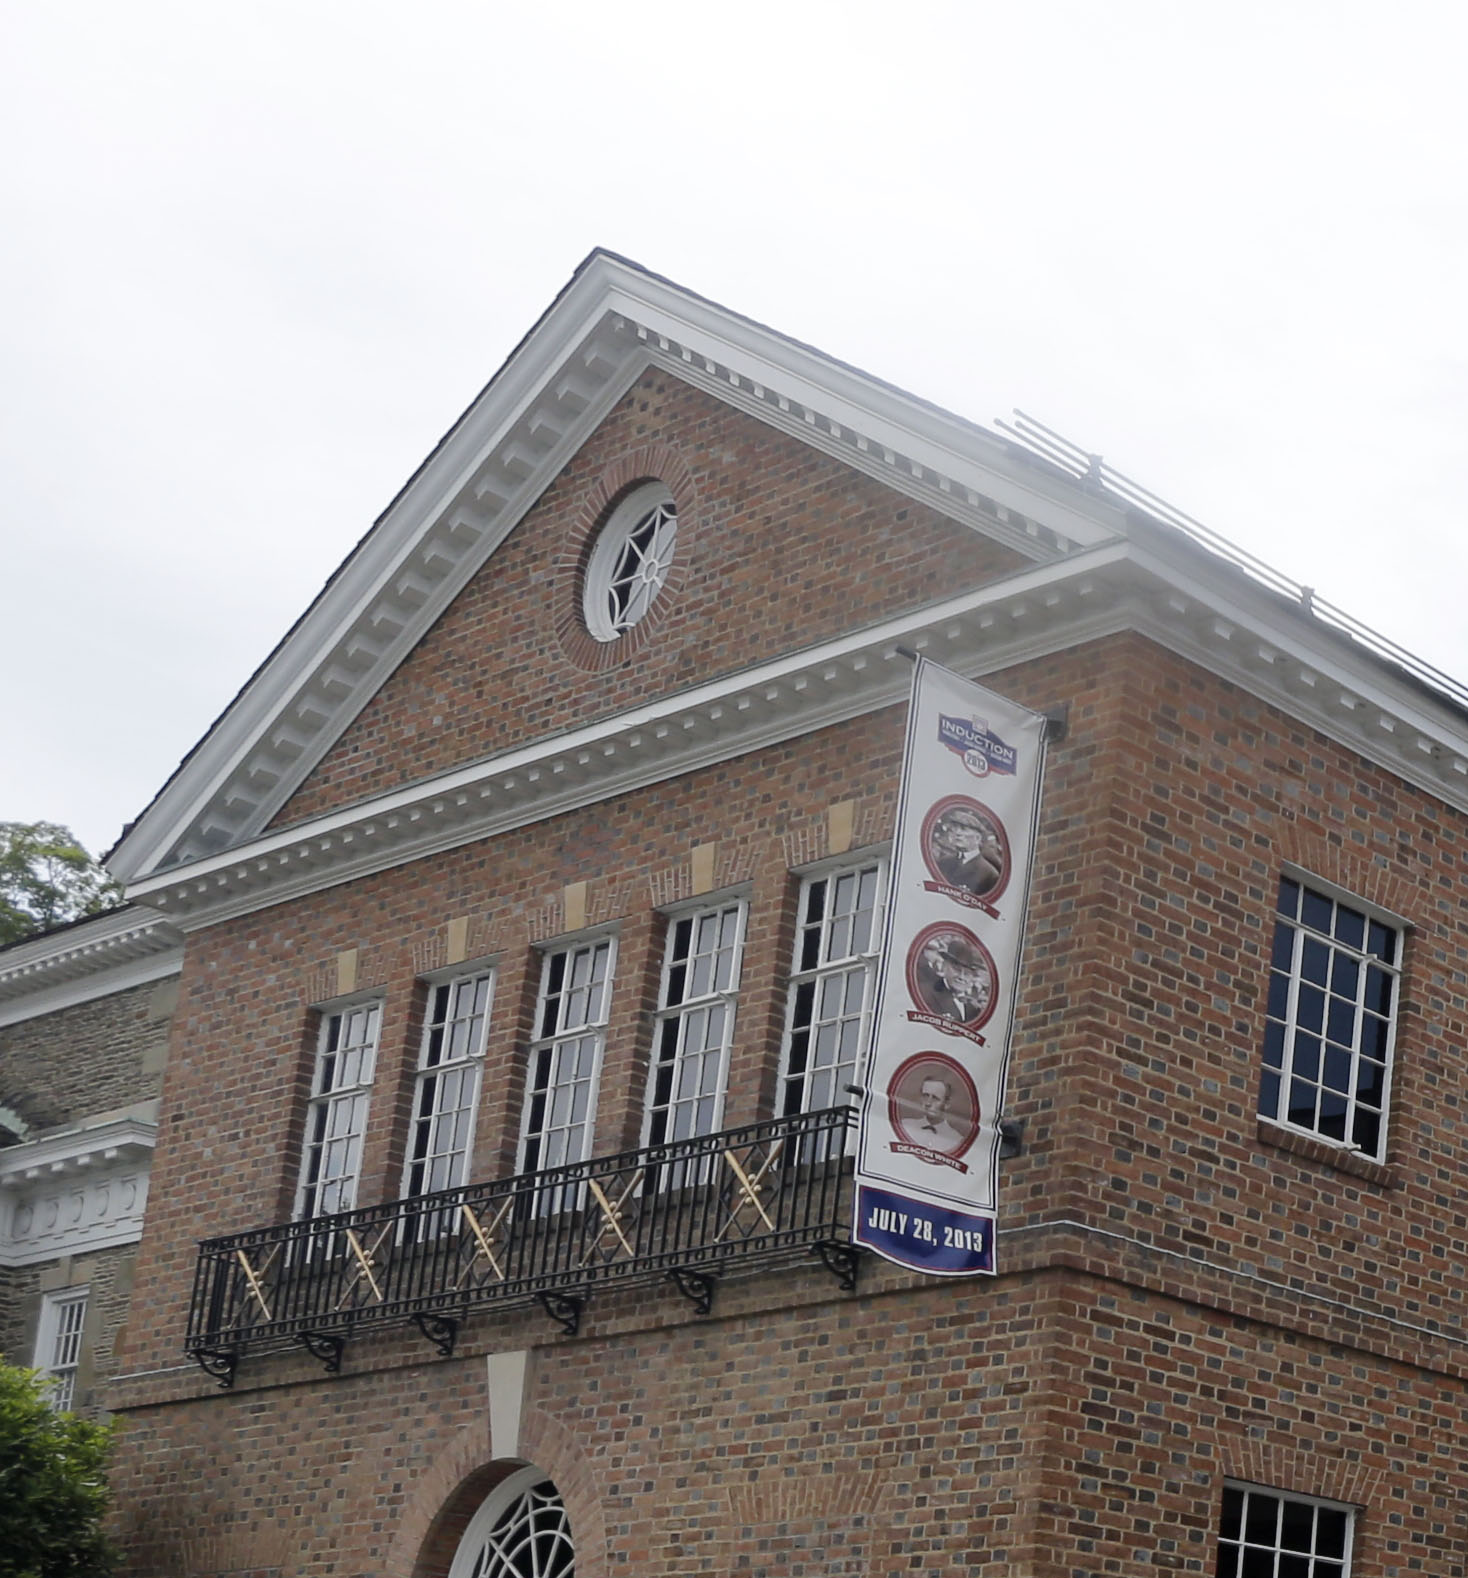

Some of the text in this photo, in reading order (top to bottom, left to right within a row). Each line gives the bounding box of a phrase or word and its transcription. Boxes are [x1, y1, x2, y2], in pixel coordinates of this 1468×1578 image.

[942, 718, 1014, 759] INDUCTION
[966, 752, 986, 771] 2013
[937, 886, 961, 897] HANK
[912, 1013, 941, 1025] JACOB
[897, 1145, 962, 1169] DEACON WHITE
[868, 1207, 983, 1252] JULY 28, 2013
